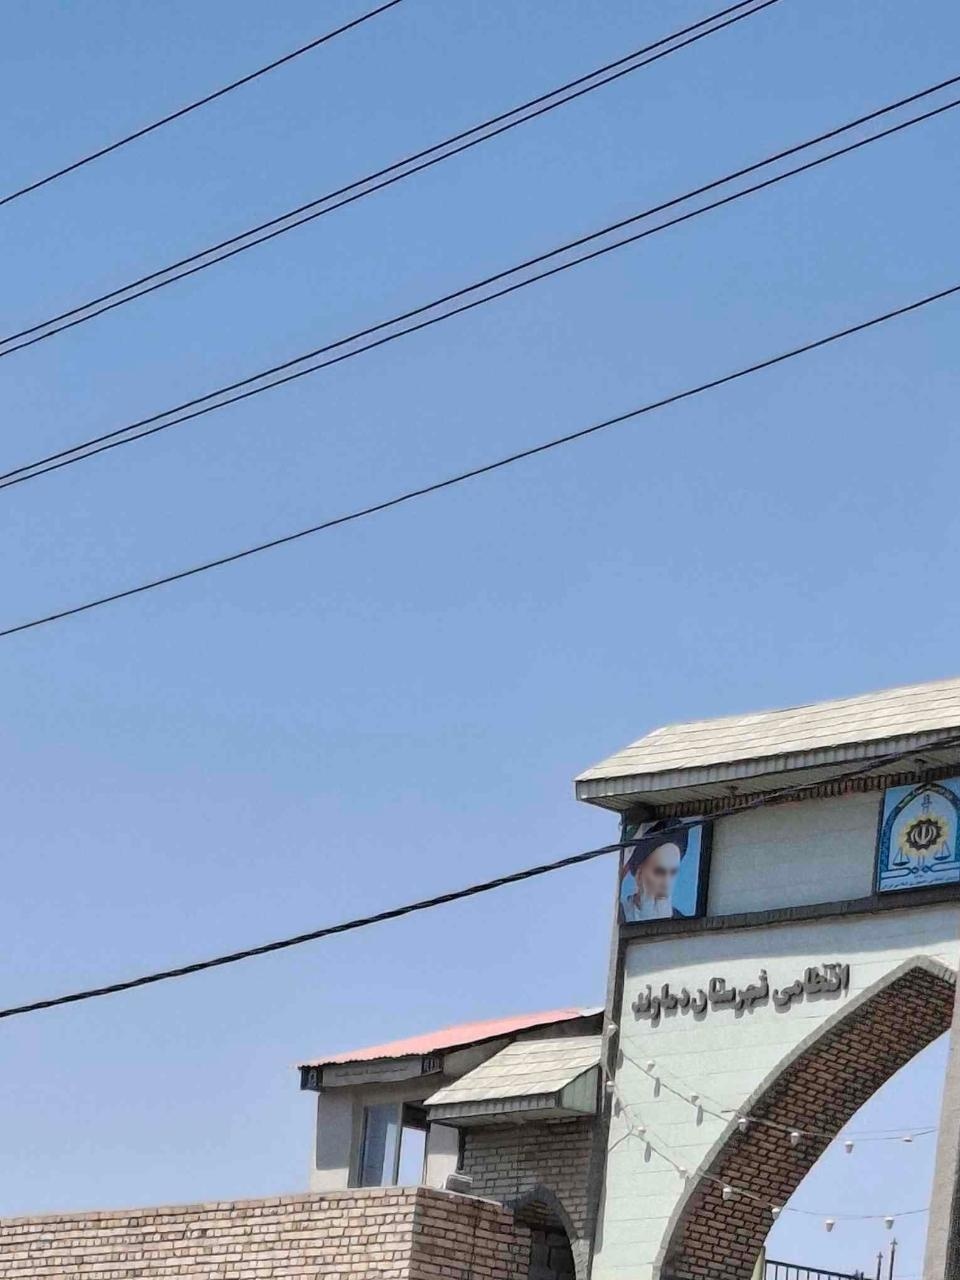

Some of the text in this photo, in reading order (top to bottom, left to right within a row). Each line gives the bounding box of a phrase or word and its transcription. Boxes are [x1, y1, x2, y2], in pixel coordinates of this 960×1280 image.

[631, 983, 691, 1022] دماوند
[692, 969, 770, 1016] شهرستان
[772, 963, 850, 1008] انتظامی
